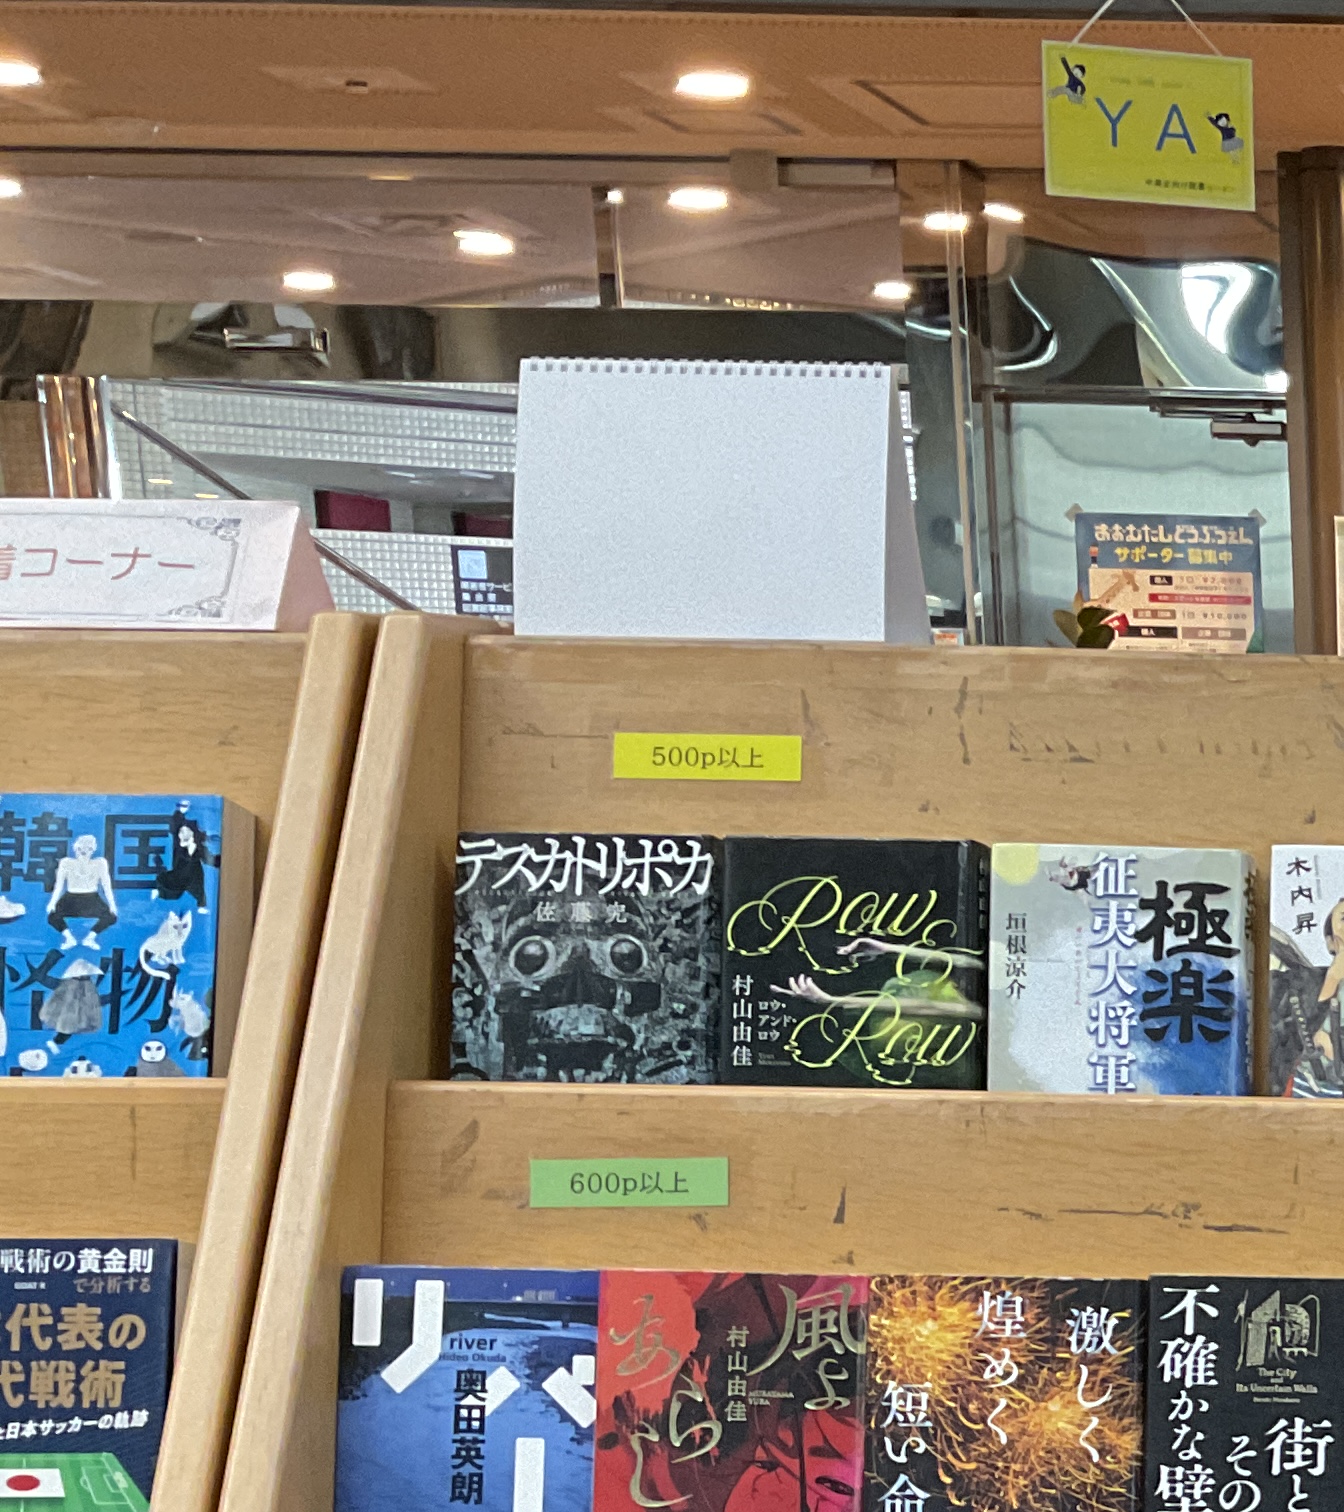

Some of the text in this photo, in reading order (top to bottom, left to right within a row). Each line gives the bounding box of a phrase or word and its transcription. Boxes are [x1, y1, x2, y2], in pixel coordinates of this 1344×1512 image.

[650, 744, 765, 770] 500p以上
[454, 836, 714, 897] テスカトリポカ
[1284, 857, 1318, 936] 木内昇
[534, 900, 628, 924] 佐藤究
[1004, 911, 1028, 997] 垣根涼介
[1087, 851, 1138, 1095] 征夷大将軍
[1134, 879, 1241, 1045] 極楽
[731, 974, 754, 1068] 村山由佳
[569, 1170, 691, 1197] 600p以上
[0, 1247, 154, 1275] 戦術の黄金則
[73, 1277, 152, 1294] で分析する
[5, 1302, 147, 1352] 代表の
[448, 1333, 498, 1353] river
[470, 1352, 508, 1363] Okuda
[747, 1283, 867, 1411] 風よ
[724, 1325, 751, 1423] 村山由佳
[974, 1290, 1029, 1445] 煌めく
[1065, 1306, 1121, 1464] 激しく
[449, 1367, 488, 1505] 奥田英朗
